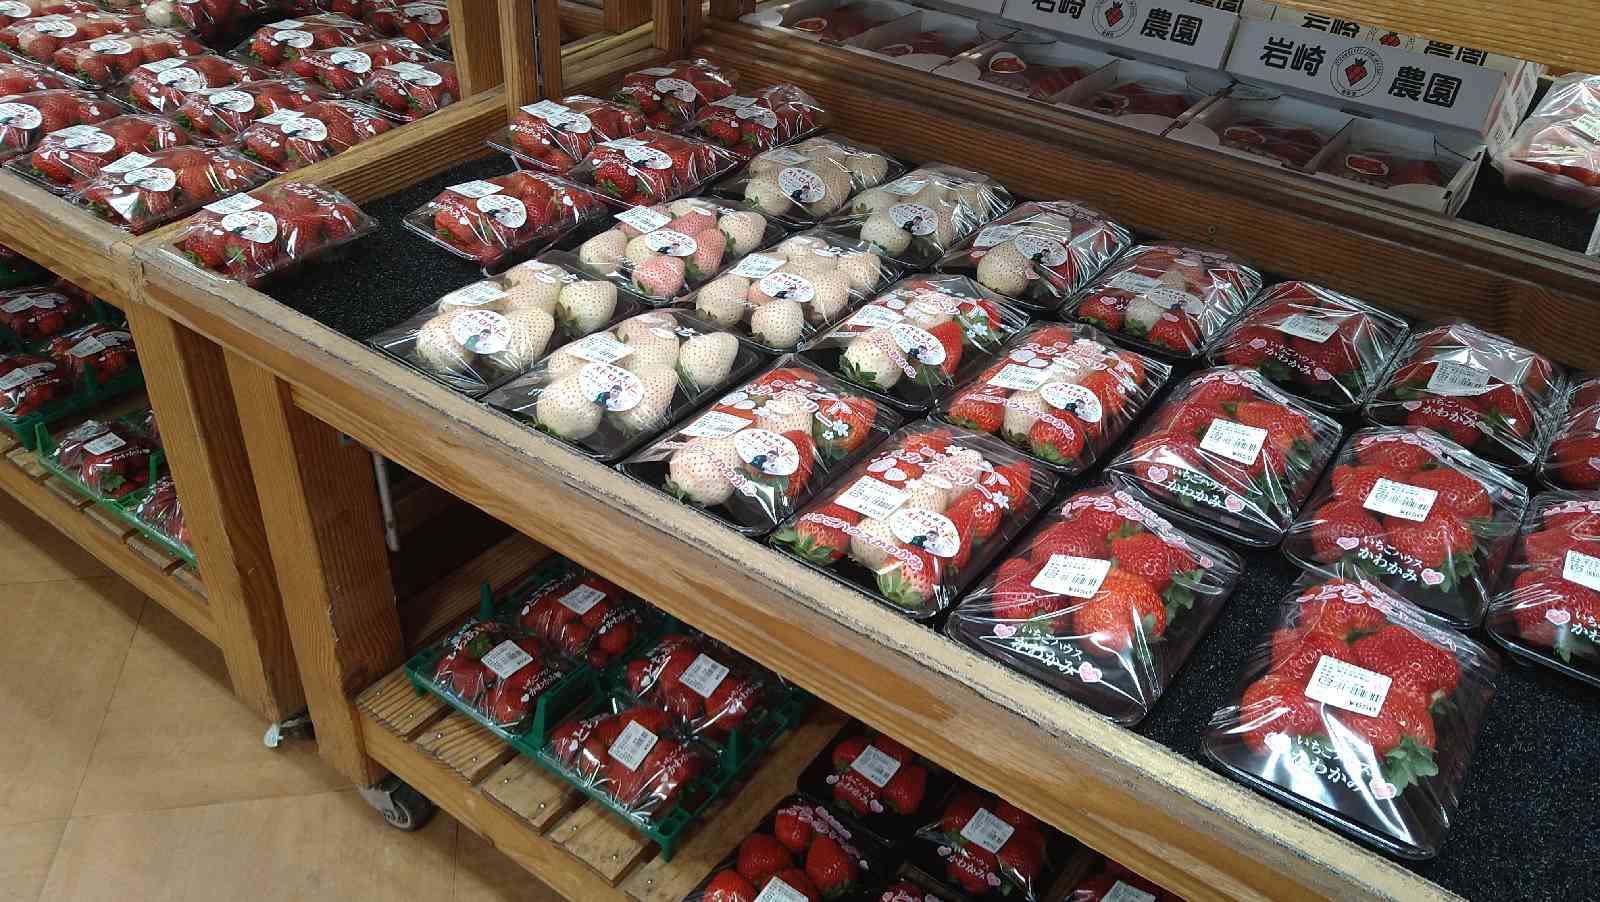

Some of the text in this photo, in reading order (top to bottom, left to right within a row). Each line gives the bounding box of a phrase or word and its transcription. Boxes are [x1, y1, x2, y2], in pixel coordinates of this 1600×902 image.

[1140, 7, 1203, 46] 農園
[1259, 36, 1327, 77] 岩崎
[1388, 65, 1463, 108] 農園
[1168, 479, 1222, 507] かわかみ
[1358, 547, 1419, 583] かわかみ
[1363, 535, 1424, 569] いちごハウス
[1010, 637, 1076, 676] かわかみ
[1021, 623, 1084, 661] いちごハウス
